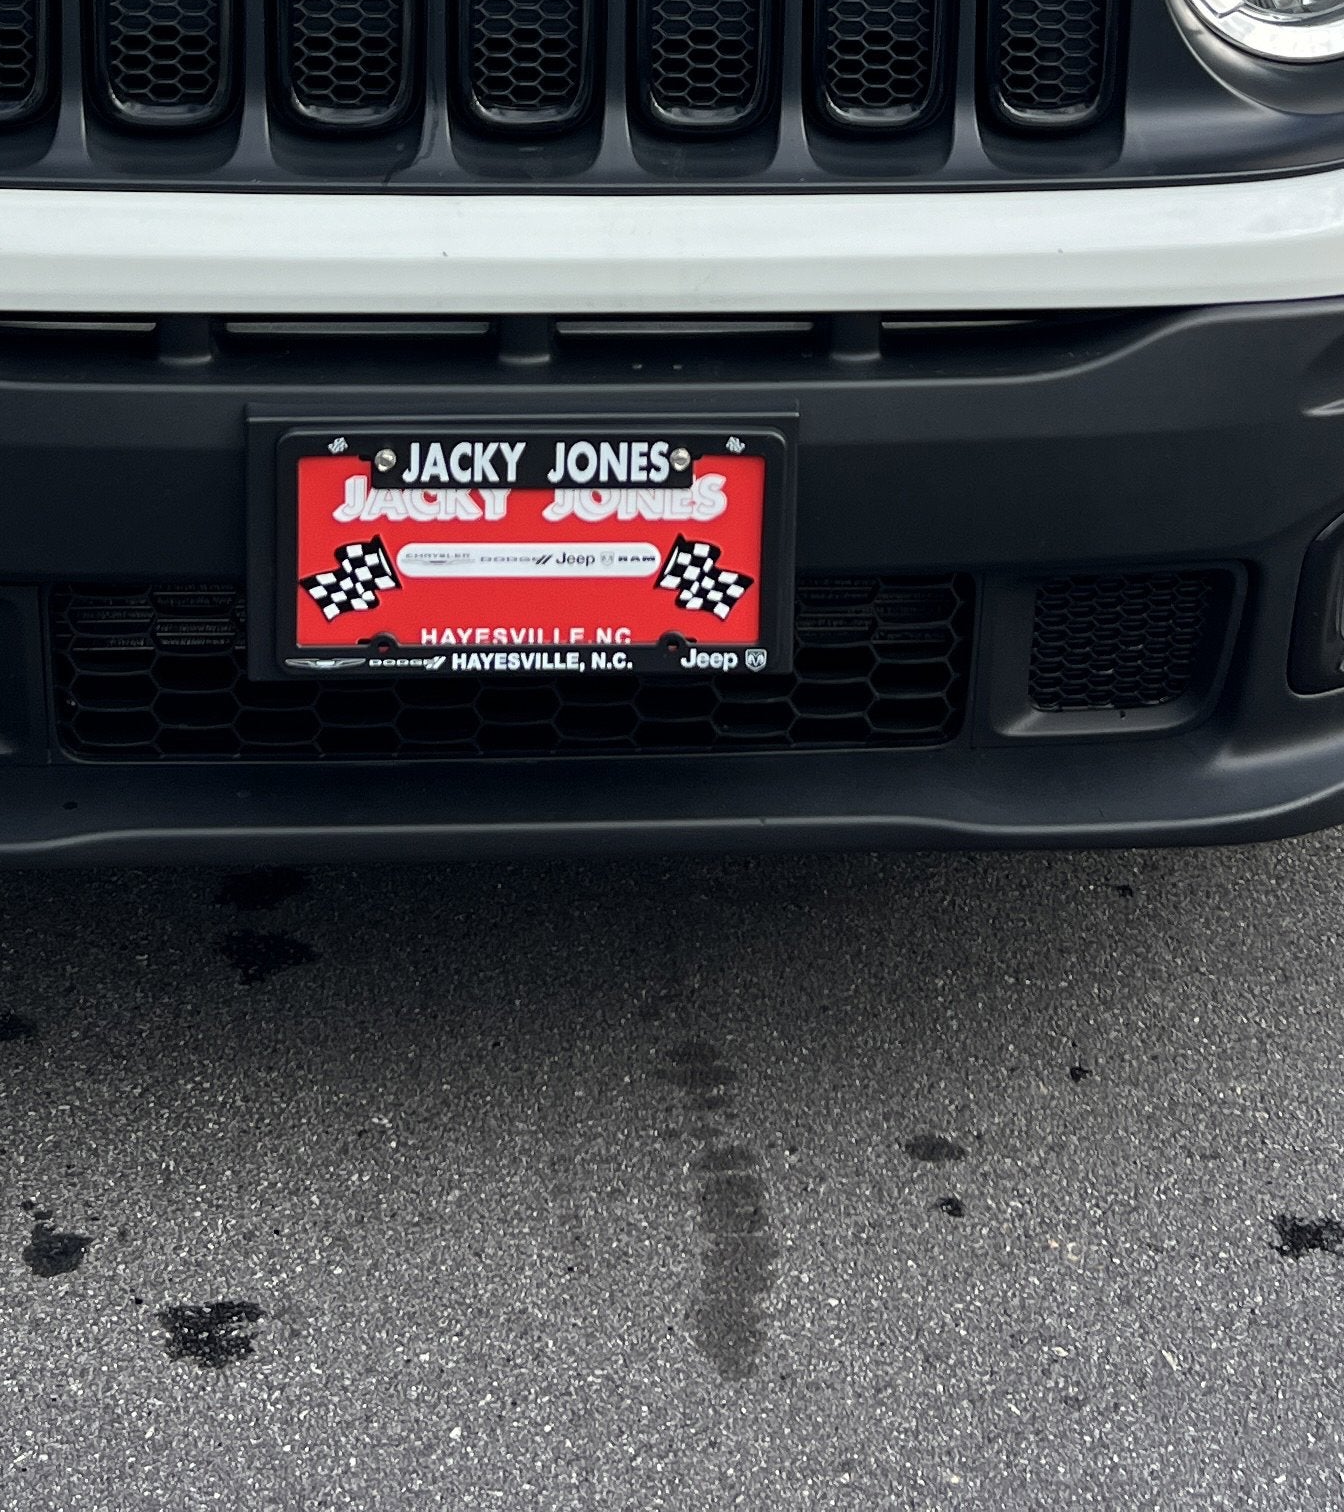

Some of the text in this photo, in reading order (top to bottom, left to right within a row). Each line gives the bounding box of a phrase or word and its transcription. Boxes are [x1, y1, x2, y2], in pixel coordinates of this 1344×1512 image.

[402, 440, 670, 484] JACKY JONES
[332, 473, 728, 523] JACKY JONES
[555, 550, 596, 567] Jeep
[451, 652, 633, 672] HAYESVILLE, N.C.
[680, 648, 738, 672] Jeep
